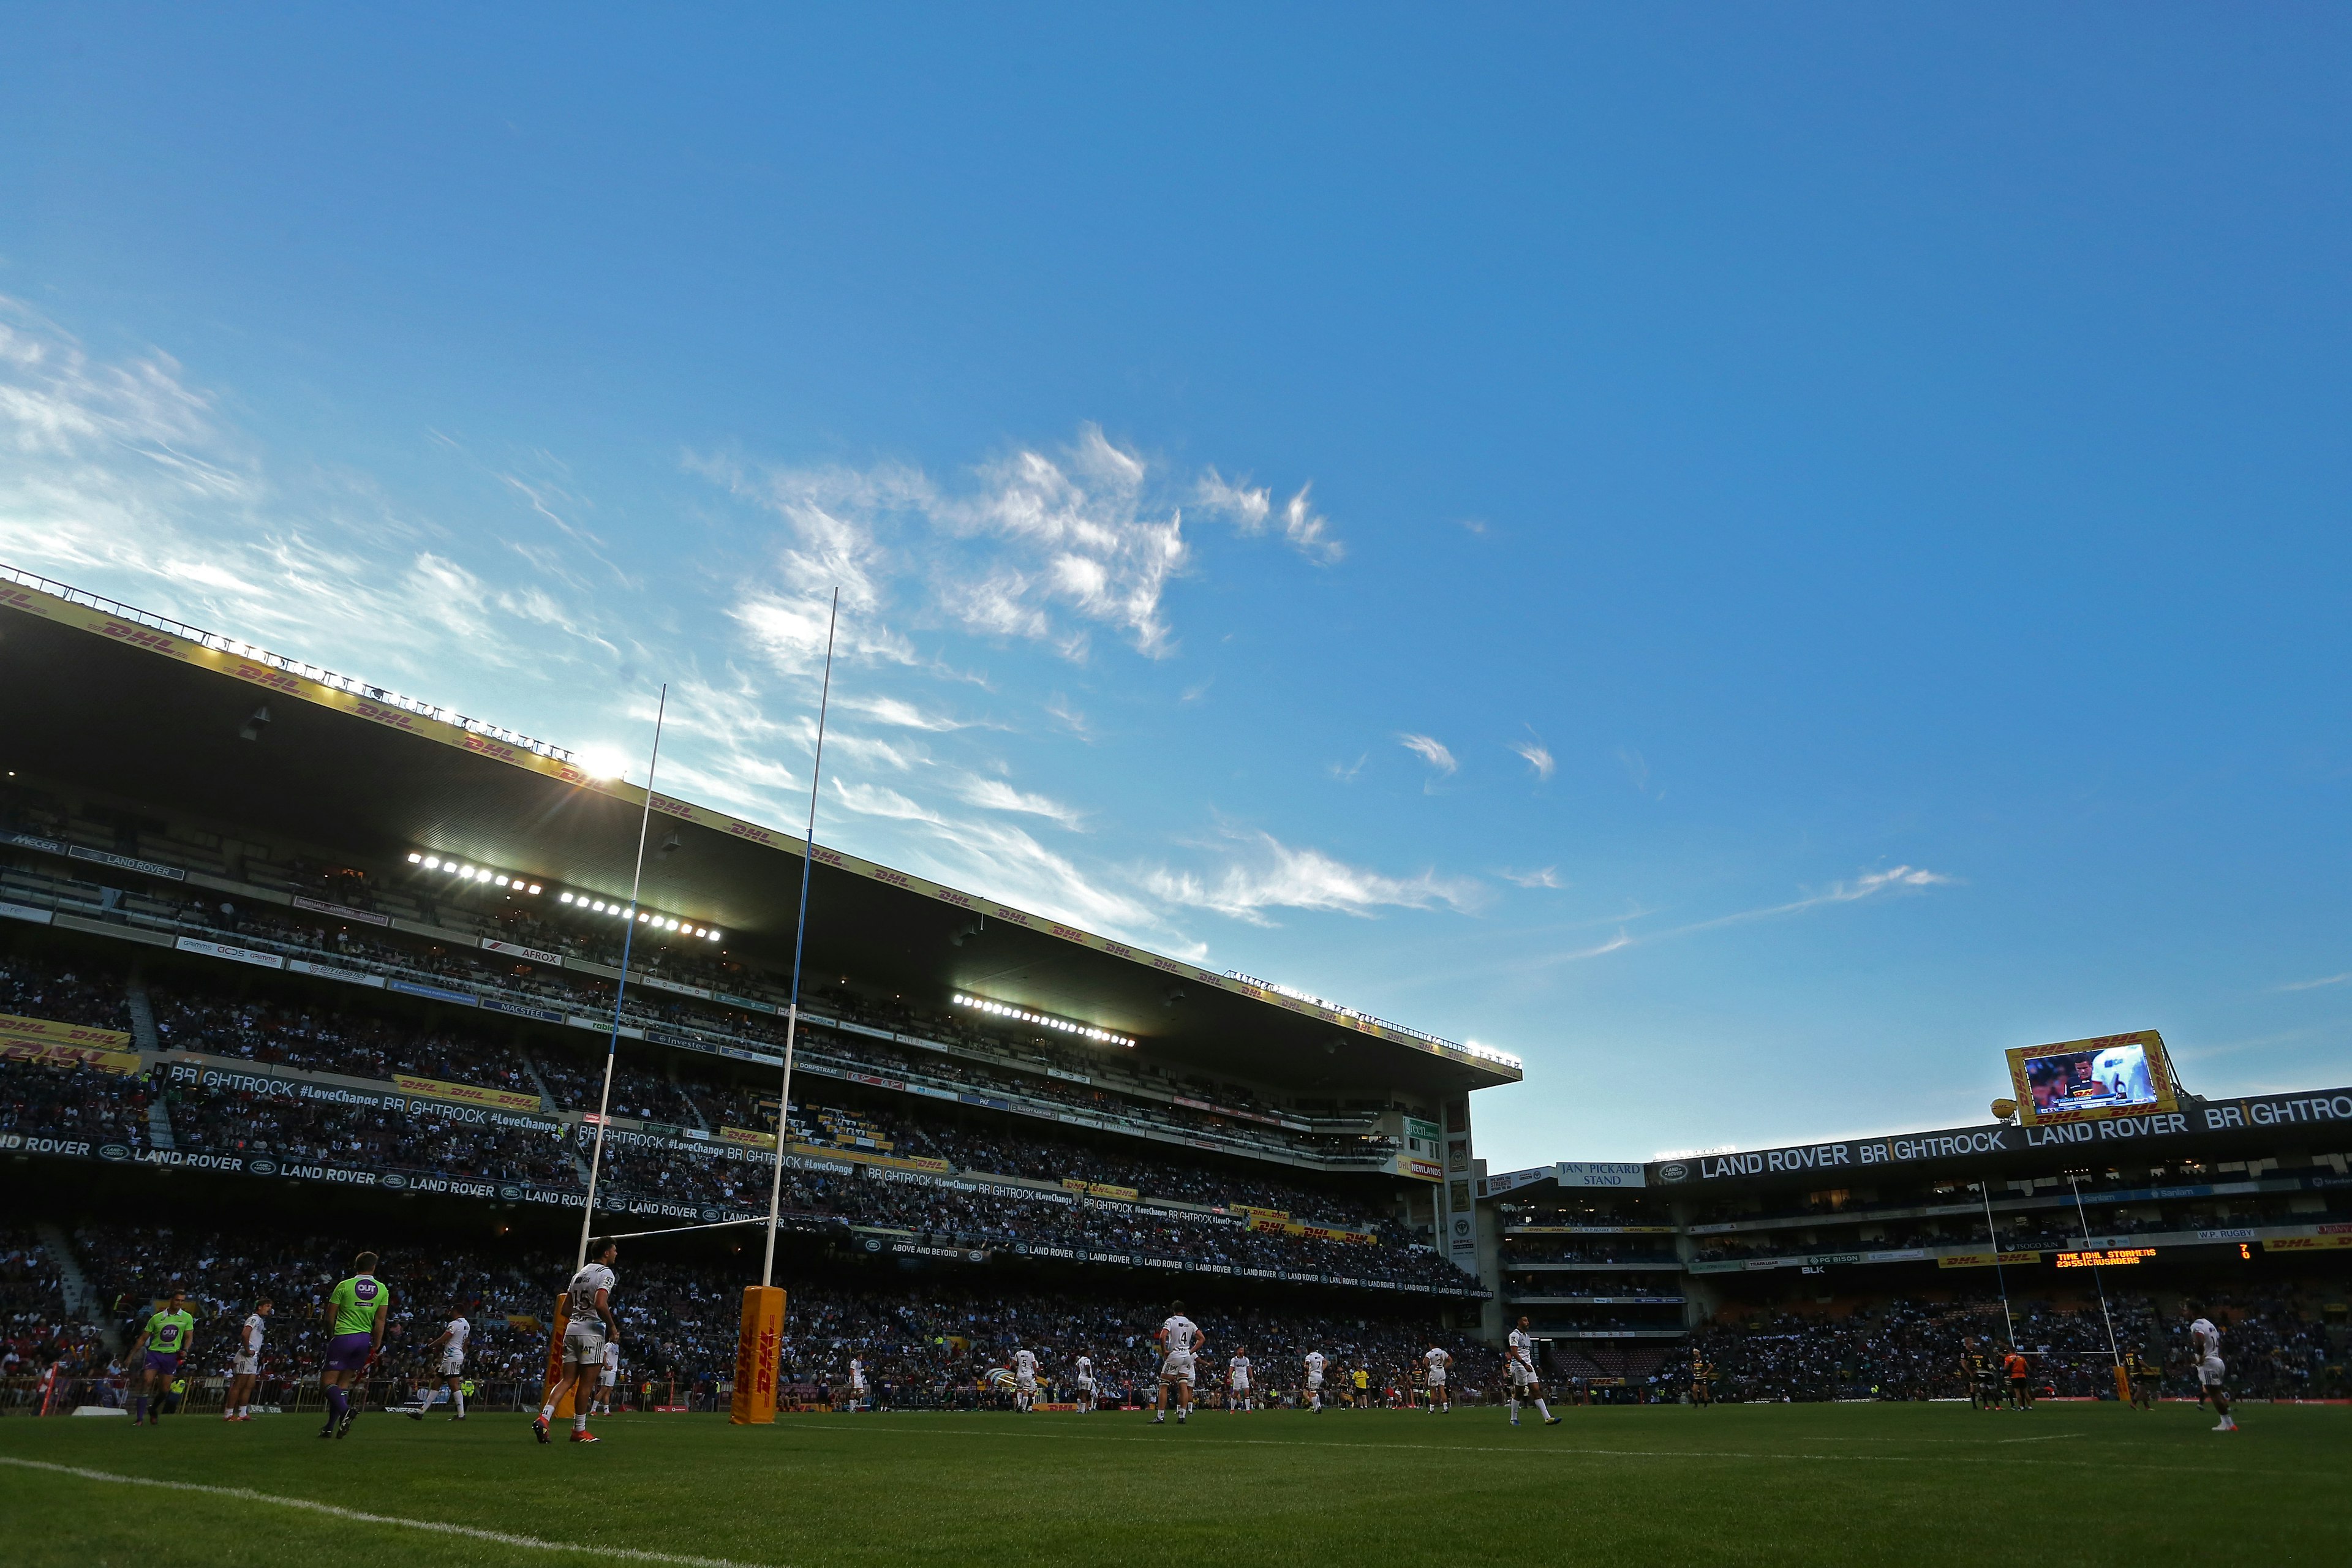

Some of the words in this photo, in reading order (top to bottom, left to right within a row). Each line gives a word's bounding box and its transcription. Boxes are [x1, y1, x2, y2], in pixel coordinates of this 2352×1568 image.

[102, 621, 175, 654] DHL
[235, 664, 303, 696] DHL
[355, 703, 414, 729] DHL
[462, 737, 516, 763] DHL
[649, 796, 693, 818] DHL
[729, 823, 772, 843] DHL
[12, 834, 59, 851] MECER
[808, 848, 843, 866] DHL
[107, 855, 135, 869] LAND
[137, 862, 170, 876] ROVER
[873, 869, 909, 888] DHL
[938, 889, 971, 908] DHL
[997, 908, 1028, 925] DHL
[1052, 925, 1084, 943] DHL
[522, 949, 557, 963] AFROX
[1105, 943, 1132, 959] DHL
[320, 966, 336, 974] CITY
[336, 968, 367, 979] LOGISTICS
[1153, 959, 1178, 973] DHL
[1198, 973, 1223, 987] DHL
[1241, 986, 1264, 998] DHL
[501, 1003, 546, 1018] MACSTEEL
[1281, 999, 1302, 1012] DHL
[1319, 1011, 1338, 1023] DHL
[0, 1019, 47, 1034] DHL
[1354, 1022, 1371, 1033] DHL
[69, 1030, 117, 1044] DHL
[668, 1036, 706, 1051] Investec
[1387, 1032, 1404, 1042] DHL
[2091, 1033, 2142, 1049] DHL
[1419, 1042, 1435, 1052] DHL
[2021, 1044, 2069, 1057] DHL
[1447, 1051, 1463, 1060] DHL
[800, 1063, 837, 1074] DORPSTRAAT
[1476, 1060, 1491, 1069] DHL
[1502, 1068, 1517, 1077] DHL
[2150, 1052, 2168, 1091] DHL
[401, 1080, 437, 1091] DHL
[2015, 1068, 2029, 1106] DHL
[300, 1085, 379, 1107] #LoveChange
[450, 1088, 484, 1099] DHL
[927, 1089, 948, 1098] MARSH
[498, 1095, 533, 1107] DHL
[2110, 1103, 2162, 1117] DHL
[491, 1113, 557, 1133] #LoveChange
[2036, 1112, 2086, 1125] DHL
[2026, 1123, 2092, 1147] LAND
[2099, 1113, 2188, 1140] ROVER
[579, 1125, 665, 1148] BRGHTROCK
[668, 1140, 724, 1156] #LoveChange
[726, 1131, 760, 1144] DHL
[26, 1137, 90, 1155] ROVER
[134, 1148, 183, 1165] LAND
[186, 1153, 242, 1171] ROVER
[918, 1160, 943, 1170] DHL
[1702, 1154, 1762, 1179] LAND
[1768, 1144, 1850, 1172] ROVER
[804, 1159, 853, 1176] #LoveChange
[1398, 1161, 1409, 1170] DHL
[1411, 1161, 1442, 1177] NEWLANDS
[1562, 1164, 1583, 1174] JAN
[1590, 1164, 1640, 1174] PICKARD
[281, 1164, 322, 1180] LAND
[326, 1169, 376, 1185] ROVER
[1585, 1175, 1621, 1185] STAND
[410, 1178, 448, 1192] LAND
[450, 1182, 494, 1197] ROVER
[935, 1177, 976, 1192] #LoveChange
[525, 1189, 558, 1203] LAND
[1035, 1191, 1072, 1205] #LoveChange
[2084, 1194, 2116, 1202] Sanlam
[629, 1201, 658, 1214] LAND
[662, 1205, 696, 1218] ROVER
[1135, 1205, 1167, 1217] #LoveChange
[723, 1212, 749, 1223] LAND
[1303, 1227, 1329, 1239] DHL
[2272, 1238, 2315, 1248] DHL
[892, 1245, 915, 1253] ABOVE
[932, 1248, 958, 1257] BEYOND
[1030, 1245, 1049, 1256] LAND
[1050, 1248, 1073, 1258] ROVER
[1997, 1253, 2030, 1262] DHL
[2107, 1249, 2156, 1258] STORMERS
[1089, 1253, 1107, 1261] LAND
[1108, 1254, 1129, 1264] ROVER
[1145, 1258, 1161, 1267] LAND
[1163, 1260, 1182, 1268] ROVER
[1833, 1254, 1858, 1264] BISON
[1947, 1256, 1980, 1265] DHL
[2087, 1257, 2140, 1267] CRUSADERS
[1196, 1263, 1212, 1272] LAND
[1213, 1265, 1231, 1273] ROVER
[1259, 1270, 1276, 1278] ROVER
[1801, 1265, 1825, 1274] BLK
[1288, 1272, 1301, 1281] LAND
[358, 1284, 375, 1292] OUT
[573, 1290, 590, 1311] 15
[1181, 1332, 1187, 1344] 4
[736, 1328, 753, 1395] DHL
[757, 1327, 774, 1395] DHL
[1022, 1359, 1027, 1368] 5
[2126, 1357, 2134, 1366] 12
